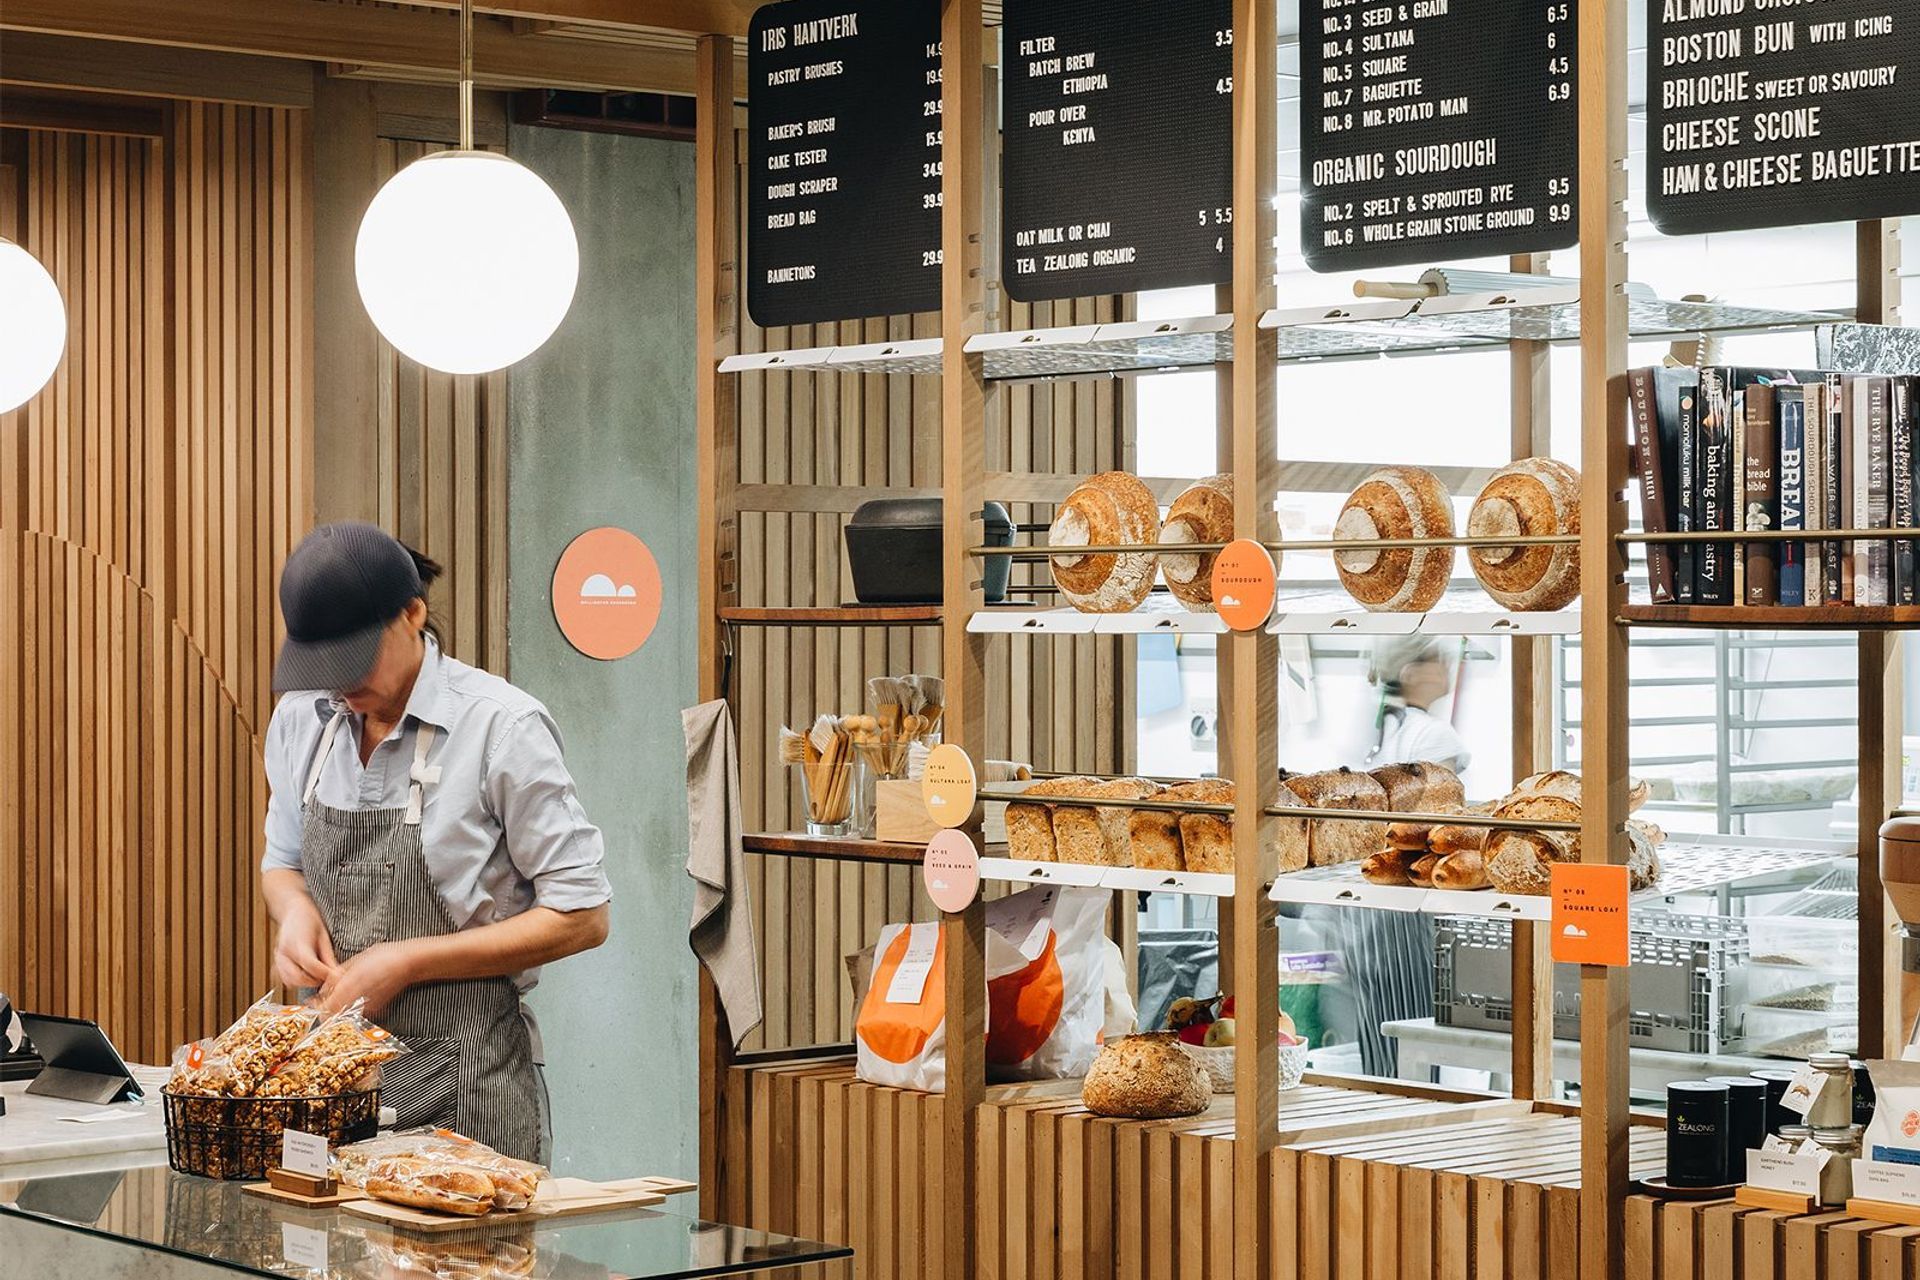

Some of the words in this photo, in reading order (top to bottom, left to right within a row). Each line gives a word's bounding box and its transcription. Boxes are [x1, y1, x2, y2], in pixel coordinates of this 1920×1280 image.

[1362, 7, 1392, 27] SEED
[1399, 5, 1408, 21] &
[1413, 0, 1448, 19] GRAIN
[1362, 29, 1414, 53] SULTANA
[1547, 4, 1568, 23] 6.5
[762, 27, 786, 52] IRIS
[793, 13, 859, 47] HANTVERK
[1020, 36, 1056, 56] FILTER
[1663, 28, 1741, 67] BOSTON
[1754, 21, 1795, 55] BUN
[1809, 21, 1846, 43] WITH
[1855, 15, 1893, 38] ICING
[1029, 58, 1061, 77] BATCH
[1066, 52, 1095, 72] BREW
[1215, 29, 1233, 47] 3.5
[1362, 55, 1407, 78] SQUARE
[1547, 32, 1556, 50] 6
[768, 67, 801, 86] PASTRY
[804, 60, 844, 80] BRUSHES
[1063, 74, 1108, 95] ETHIOPIA
[1362, 78, 1422, 103] BAGUETTE
[1549, 57, 1569, 74] 4.5
[1663, 71, 1749, 110] BRIOCHE
[1755, 77, 1805, 101] SWEET
[1808, 74, 1828, 94] OR
[1831, 65, 1897, 91] SAVOURY
[1029, 109, 1055, 127] POUR
[1060, 105, 1086, 123] OVER
[1216, 77, 1233, 94] 4.5
[1440, 97, 1468, 118] MAN
[1548, 82, 1570, 102] 6.9
[768, 122, 803, 141] BAKER'S
[807, 117, 836, 136] BRUSH
[1063, 127, 1096, 146] KENYA
[1663, 116, 1740, 153] CHEESE
[1754, 107, 1821, 142] SCONE
[768, 156, 790, 170] CAKE
[794, 149, 828, 167] TESTER
[1313, 152, 1385, 187] ORGANIC
[1395, 138, 1497, 177] SOURDOUGH
[1663, 164, 1700, 195] HAM
[1704, 162, 1718, 191] &
[1723, 154, 1802, 190] CHEESE
[1812, 140, 1920, 181] BAGUETTE
[768, 182, 796, 200] DOUGH
[799, 177, 838, 196] SCRAPER
[1363, 197, 1400, 218] SPELT
[1406, 195, 1417, 212] &
[1422, 187, 1483, 211] SPROUTED
[1491, 184, 1514, 204] RYE
[1548, 178, 1569, 197] 9.5
[767, 212, 796, 229] BREAD
[799, 209, 817, 226] BAG
[1016, 230, 1037, 247] OAT
[1038, 226, 1064, 244] MILK
[1068, 225, 1082, 241] OR
[1087, 222, 1111, 239] CHAI
[1199, 210, 1206, 226] 5
[1215, 207, 1233, 225] 5.5
[1363, 222, 1404, 243] WHOLE
[1407, 217, 1442, 240] GRAIN
[1444, 212, 1484, 234] STONE
[1486, 207, 1535, 229] GROUND
[1549, 204, 1571, 223] 9.9
[1016, 258, 1036, 274] TEA
[1044, 252, 1089, 272] ZEALONG
[1093, 247, 1136, 266] ORGANIC
[1215, 237, 1224, 253] 4
[767, 265, 816, 284] BANNETONS
[1807, 396, 1815, 415] THE
[1872, 387, 1881, 414] THE
[1635, 376, 1650, 458] BOUCHON
[1644, 469, 1656, 501] BAKERY
[1682, 414, 1691, 464] momofuku
[1807, 417, 1815, 477] SOURDOUGH
[1872, 418, 1881, 443] RYE
[1682, 467, 1691, 488] milk
[1703, 445, 1719, 497] baking
[1747, 456, 1759, 466] the
[1747, 467, 1770, 479] bread
[1872, 446, 1881, 488] BAKER
[1900, 451, 1910, 477] Bread
[1682, 490, 1691, 508] bar
[1747, 481, 1767, 491] bible
[1807, 479, 1815, 517] SCHOOL
[1828, 464, 1836, 501] WATER
[1706, 501, 1719, 530] and
[1733, 487, 1743, 531] handma
[1702, 543, 1716, 582] astry
[1828, 542, 1836, 569] EAST
[1678, 1122, 1715, 1132] ZEALONG
